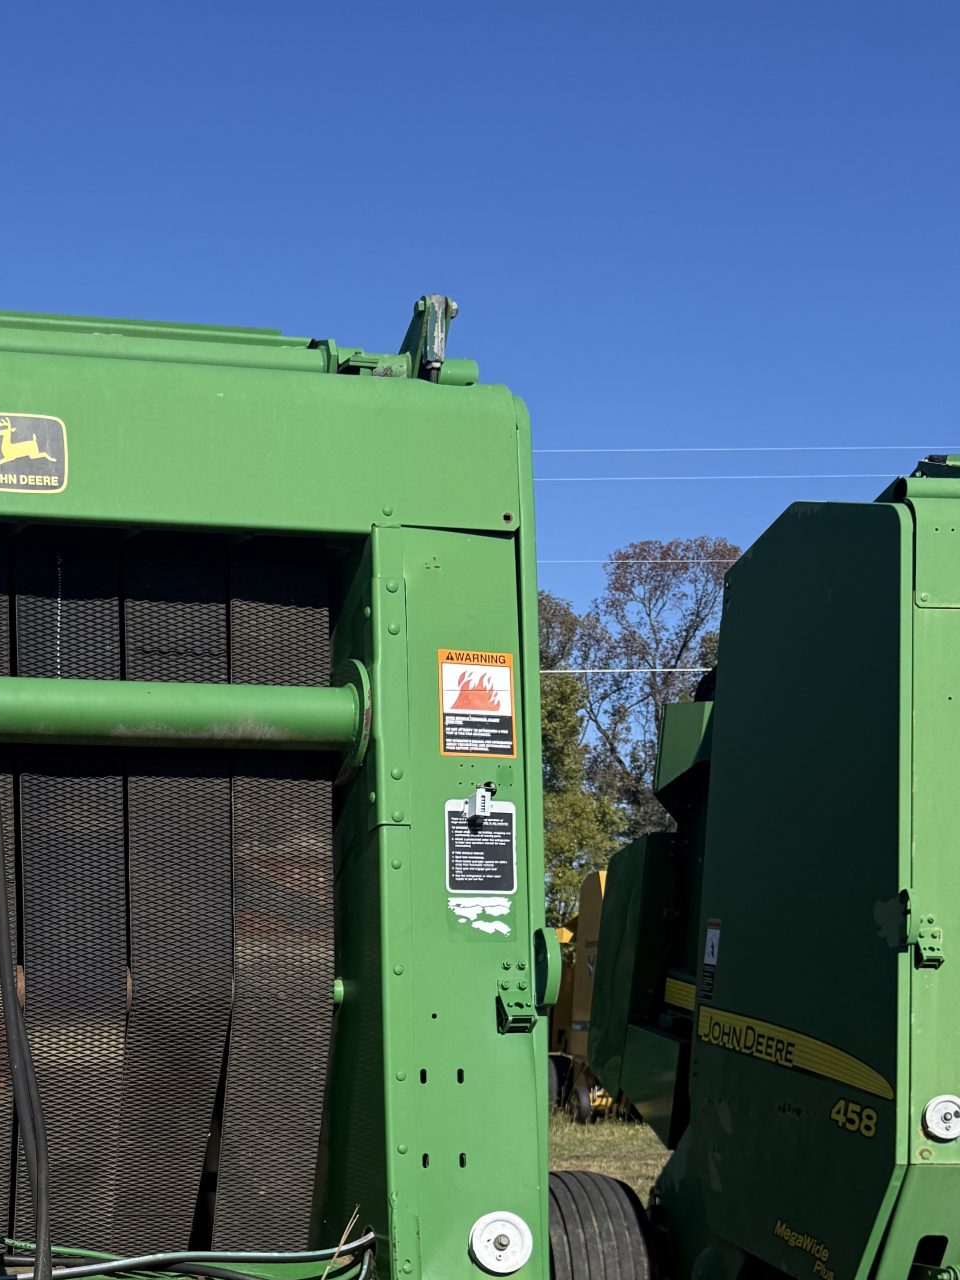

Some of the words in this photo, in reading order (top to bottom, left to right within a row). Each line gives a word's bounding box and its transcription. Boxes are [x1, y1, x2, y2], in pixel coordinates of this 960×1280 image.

[20, 475, 58, 486] DEERE
[455, 652, 506, 664] WARNING
[703, 1015, 742, 1049] JOHN
[743, 1025, 795, 1064] DEERE
[831, 1100, 878, 1137] 458
[774, 1220, 829, 1262] MegaWide
